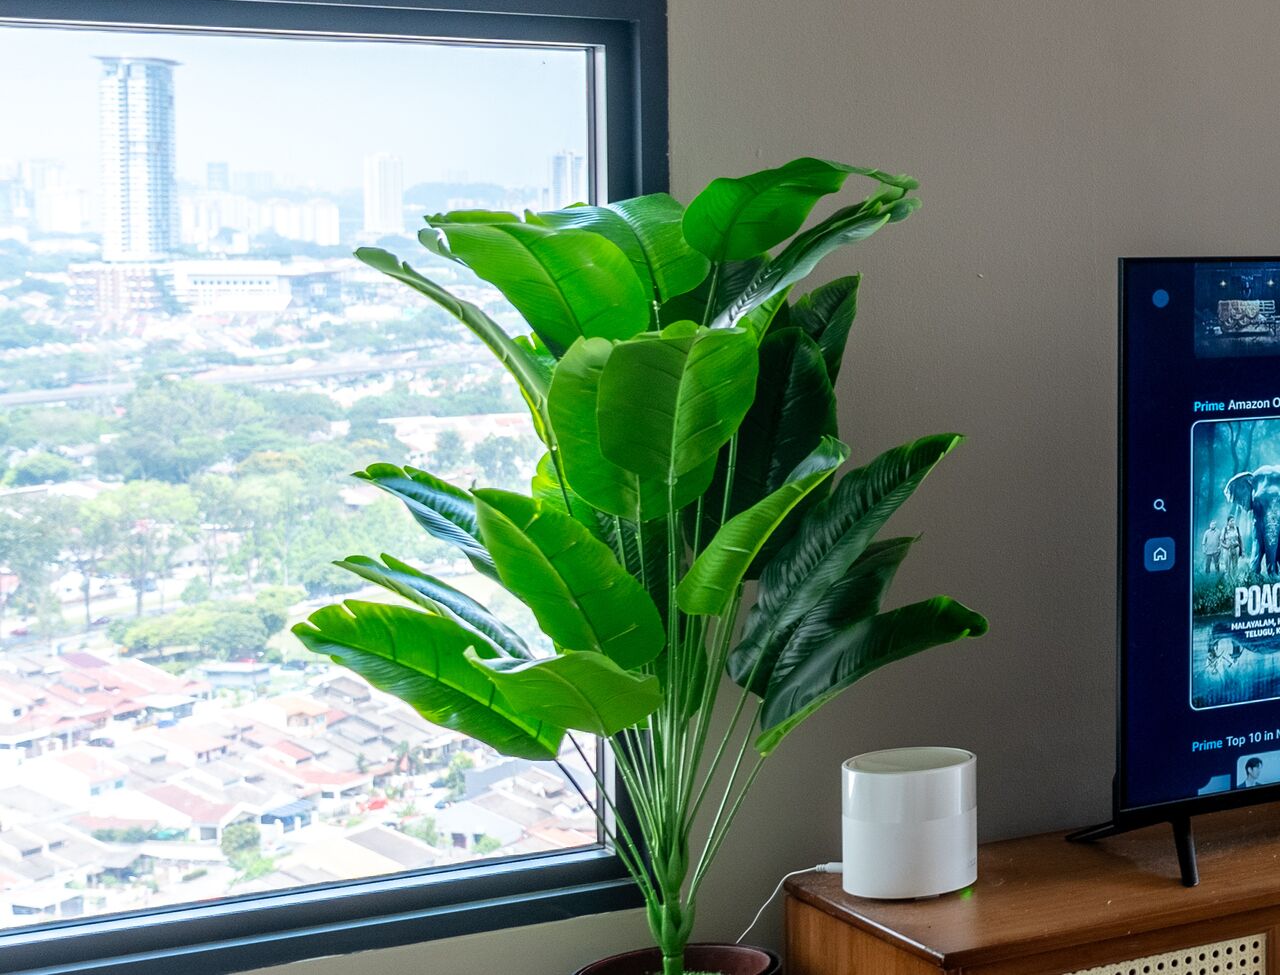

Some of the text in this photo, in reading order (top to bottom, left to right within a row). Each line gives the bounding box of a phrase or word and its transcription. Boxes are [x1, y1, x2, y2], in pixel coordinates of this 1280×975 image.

[1194, 401, 1225, 412] Prime
[1228, 398, 1270, 411] Amazon
[1231, 619, 1276, 631] MALAYALAM,
[1245, 629, 1275, 638] TELUGU,
[1192, 739, 1223, 752] Prime
[1226, 735, 1246, 747] Top
[1249, 732, 1262, 743] 10
[1264, 730, 1274, 741] in
